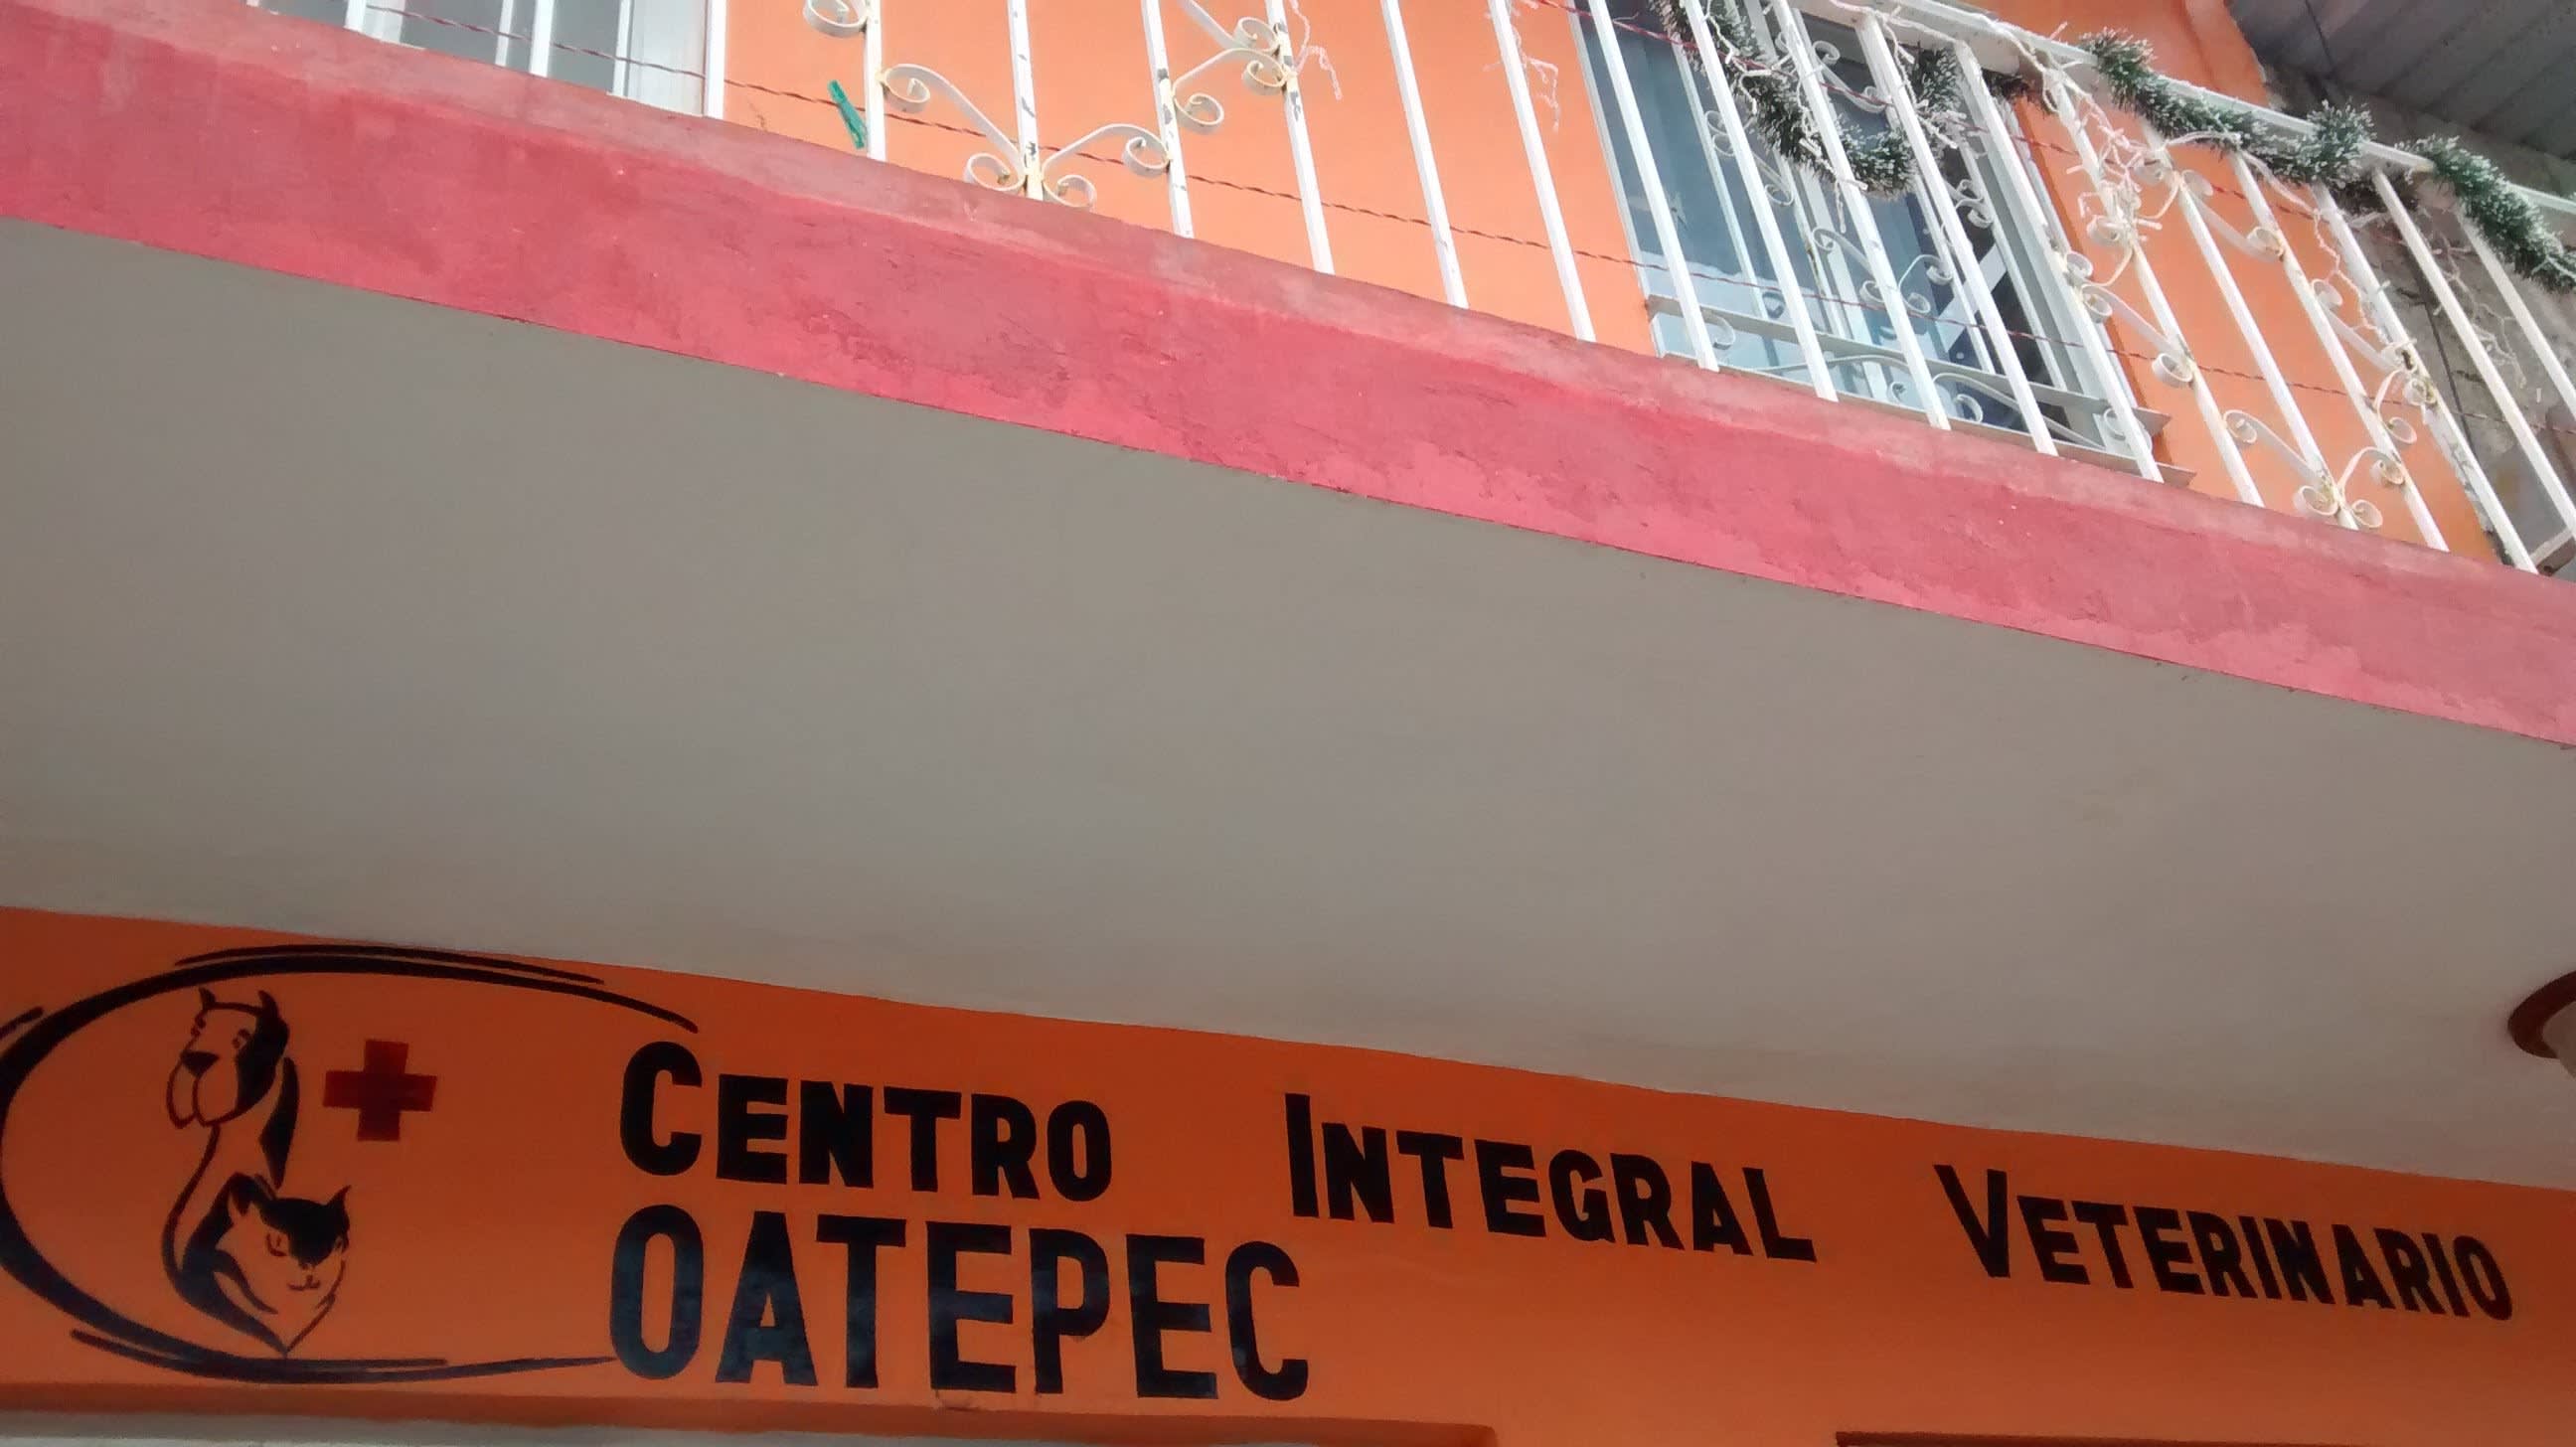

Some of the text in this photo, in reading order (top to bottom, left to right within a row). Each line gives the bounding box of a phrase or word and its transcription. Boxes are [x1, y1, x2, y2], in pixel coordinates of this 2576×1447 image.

[619, 1041, 2513, 1321] CENTRO INTEGRAL VETERINARIO
[609, 1204, 1309, 1401] OATEPEC
